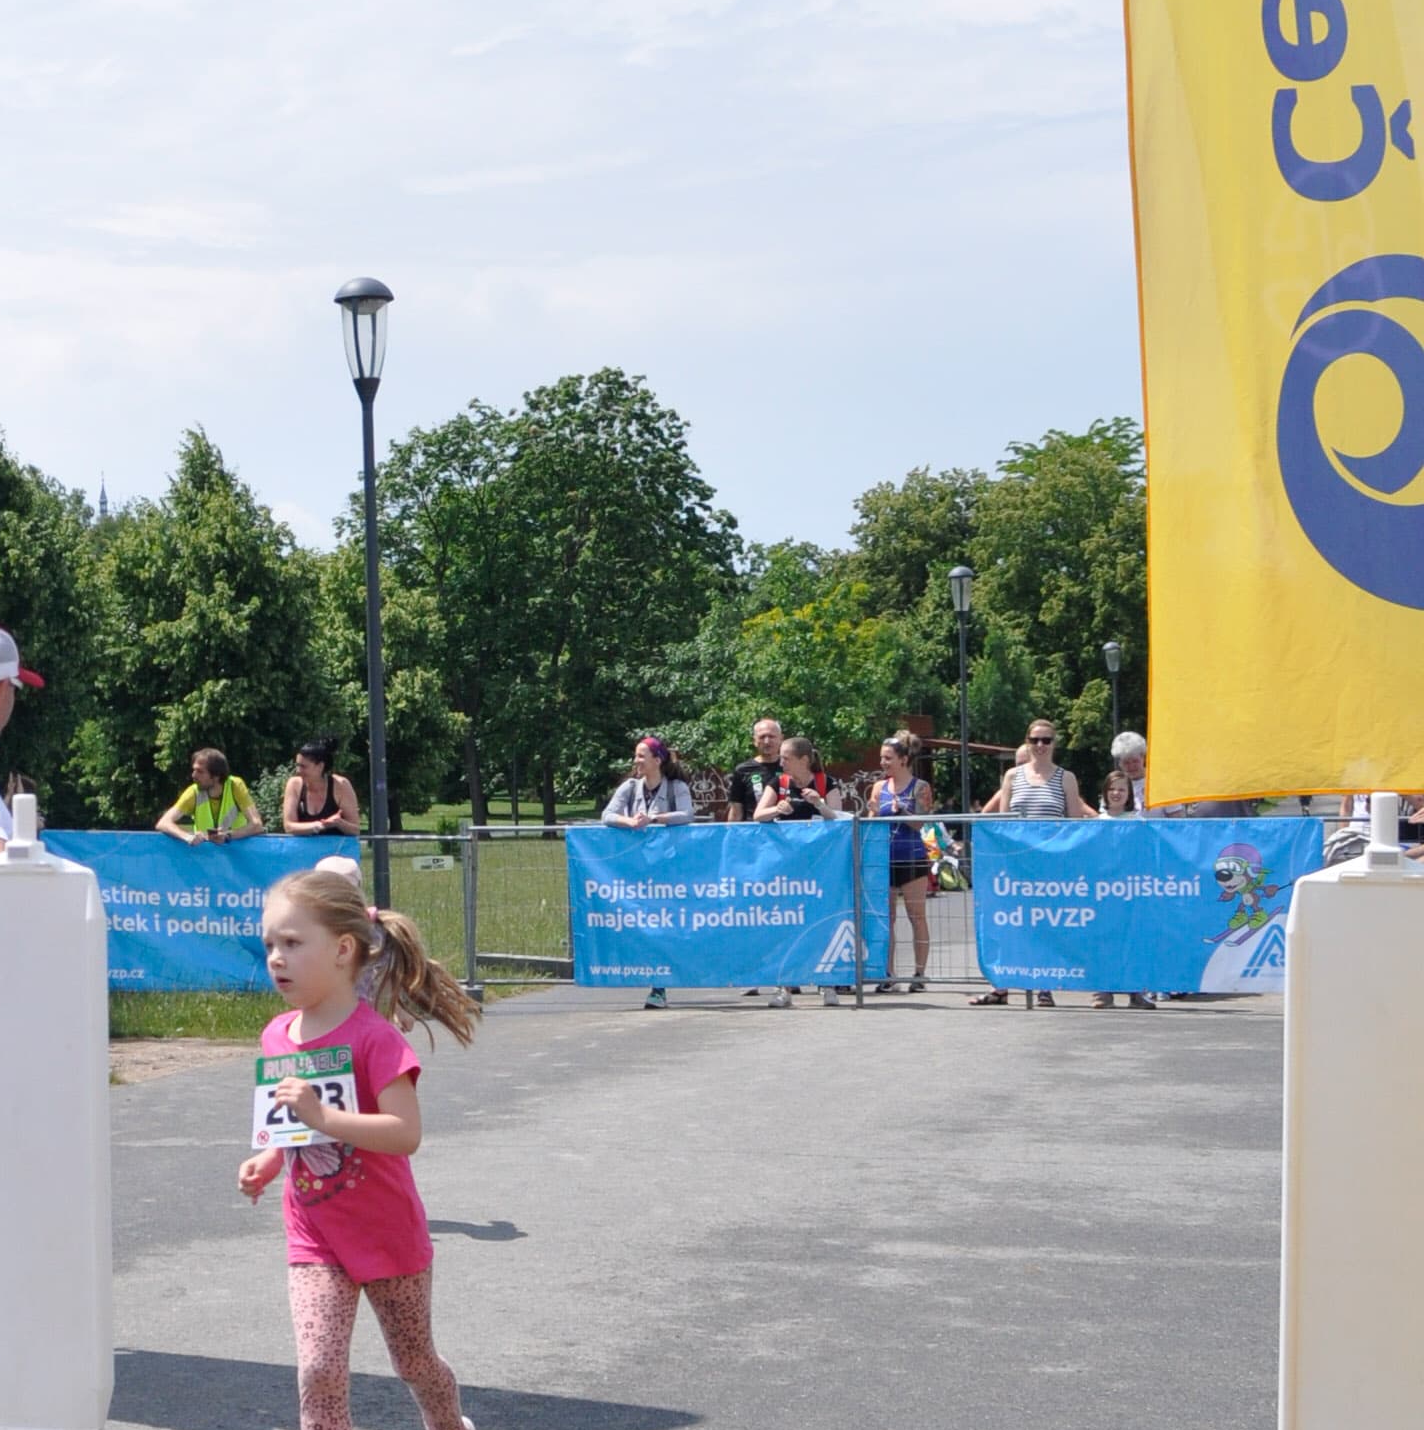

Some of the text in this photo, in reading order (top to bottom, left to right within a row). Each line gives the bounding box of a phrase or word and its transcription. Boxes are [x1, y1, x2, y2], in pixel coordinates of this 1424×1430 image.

[167, 886, 211, 909] vaši
[584, 875, 824, 904] Pojistíme vaši rodinu,
[992, 871, 1202, 902] Úrazové pojištění
[154, 914, 161, 933] i
[586, 903, 806, 933] majetek i podnikání
[993, 905, 1096, 928] od PVZP
[588, 963, 671, 978] www.pvzp.cz
[992, 965, 1086, 980] www.pvzp.cz
